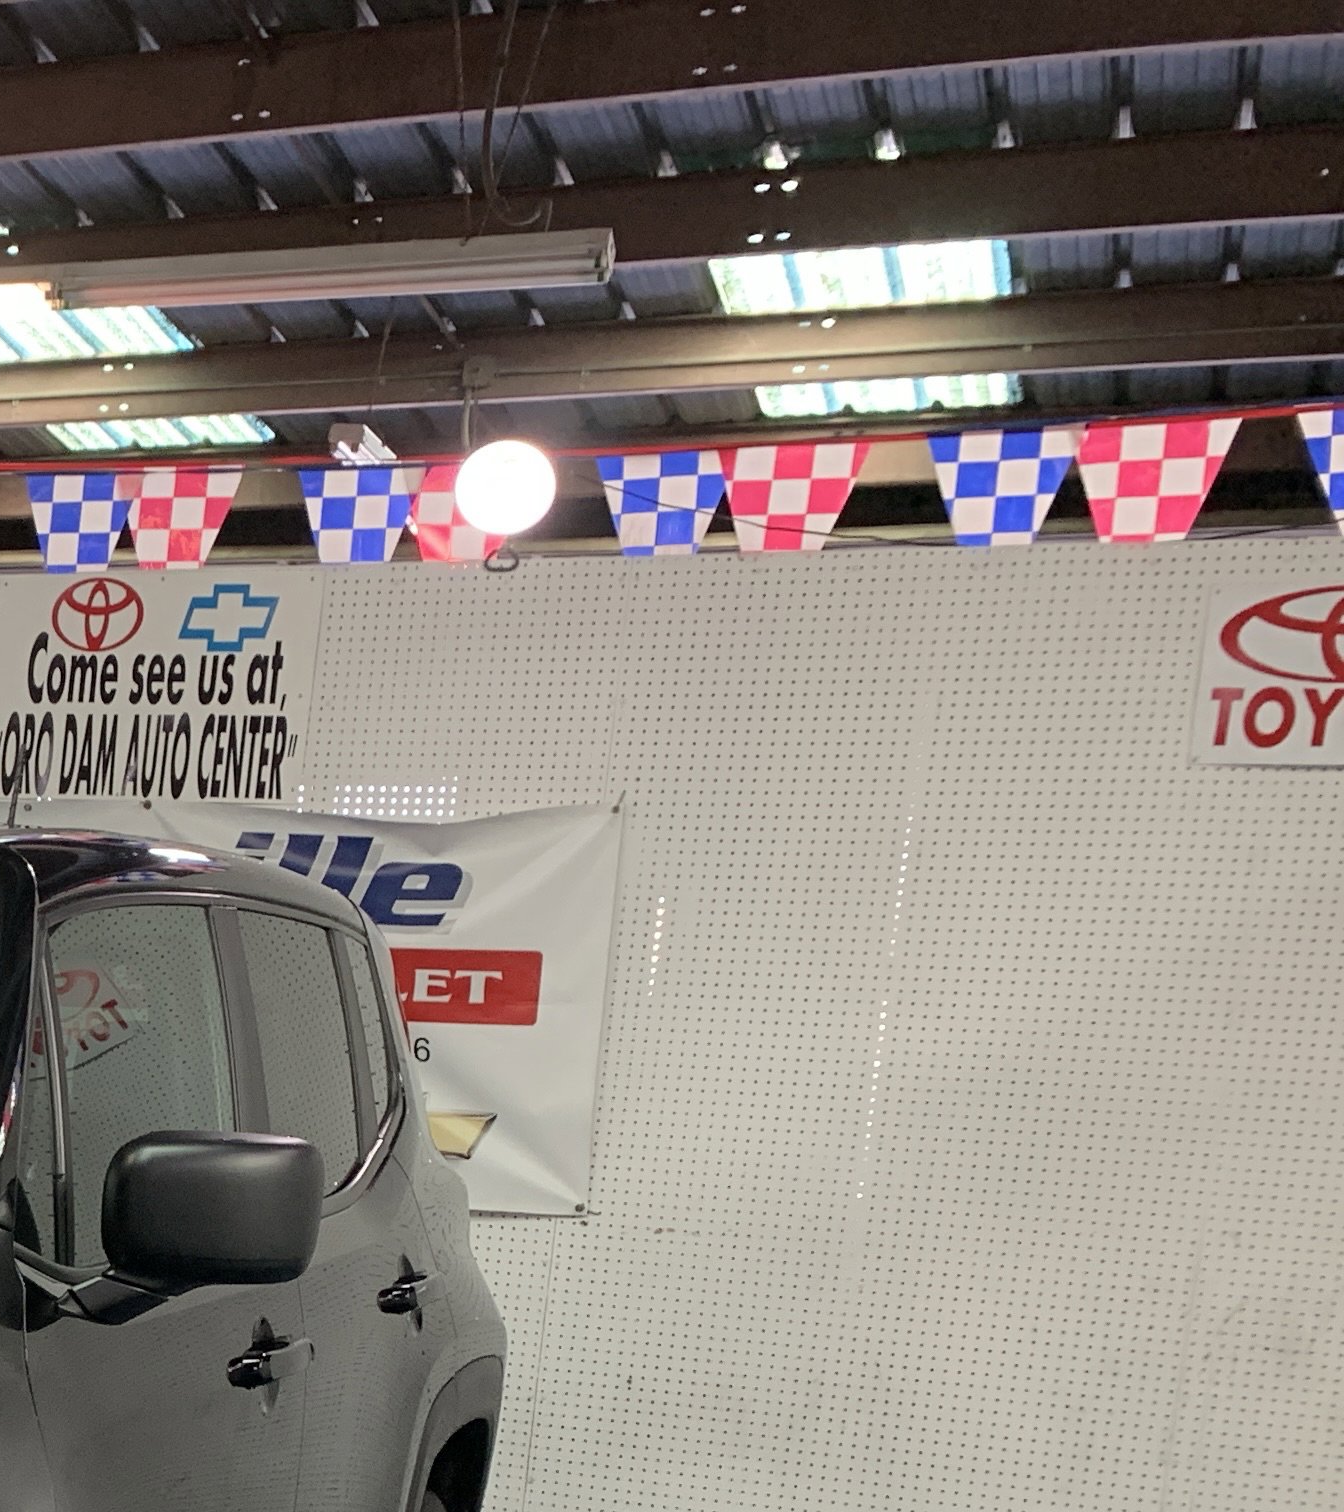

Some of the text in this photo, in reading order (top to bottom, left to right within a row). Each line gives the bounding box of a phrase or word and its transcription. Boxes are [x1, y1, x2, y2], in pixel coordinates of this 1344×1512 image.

[27, 631, 287, 711] Come see us at,
[1210, 686, 1344, 748] TOY
[59, 713, 118, 796] DAM
[121, 712, 191, 799] AUTO
[197, 713, 298, 799] CENTER"
[398, 968, 503, 1004] ET
